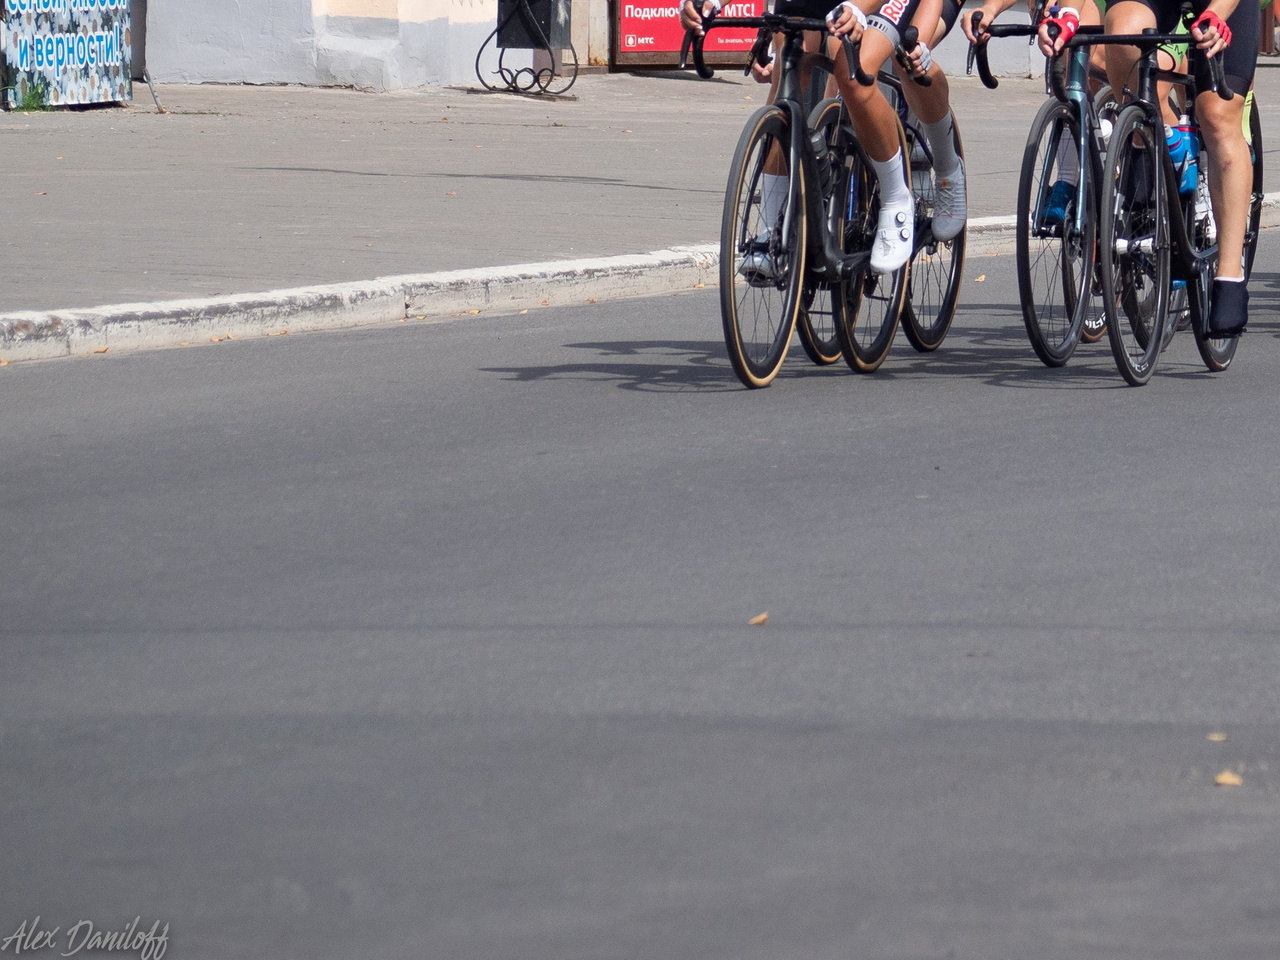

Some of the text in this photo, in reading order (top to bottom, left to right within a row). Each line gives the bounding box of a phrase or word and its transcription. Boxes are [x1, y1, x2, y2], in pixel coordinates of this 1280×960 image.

[724, 3, 755, 17] МТС!
[637, 36, 654, 44] МТС
[19, 23, 120, 76] и верности!
